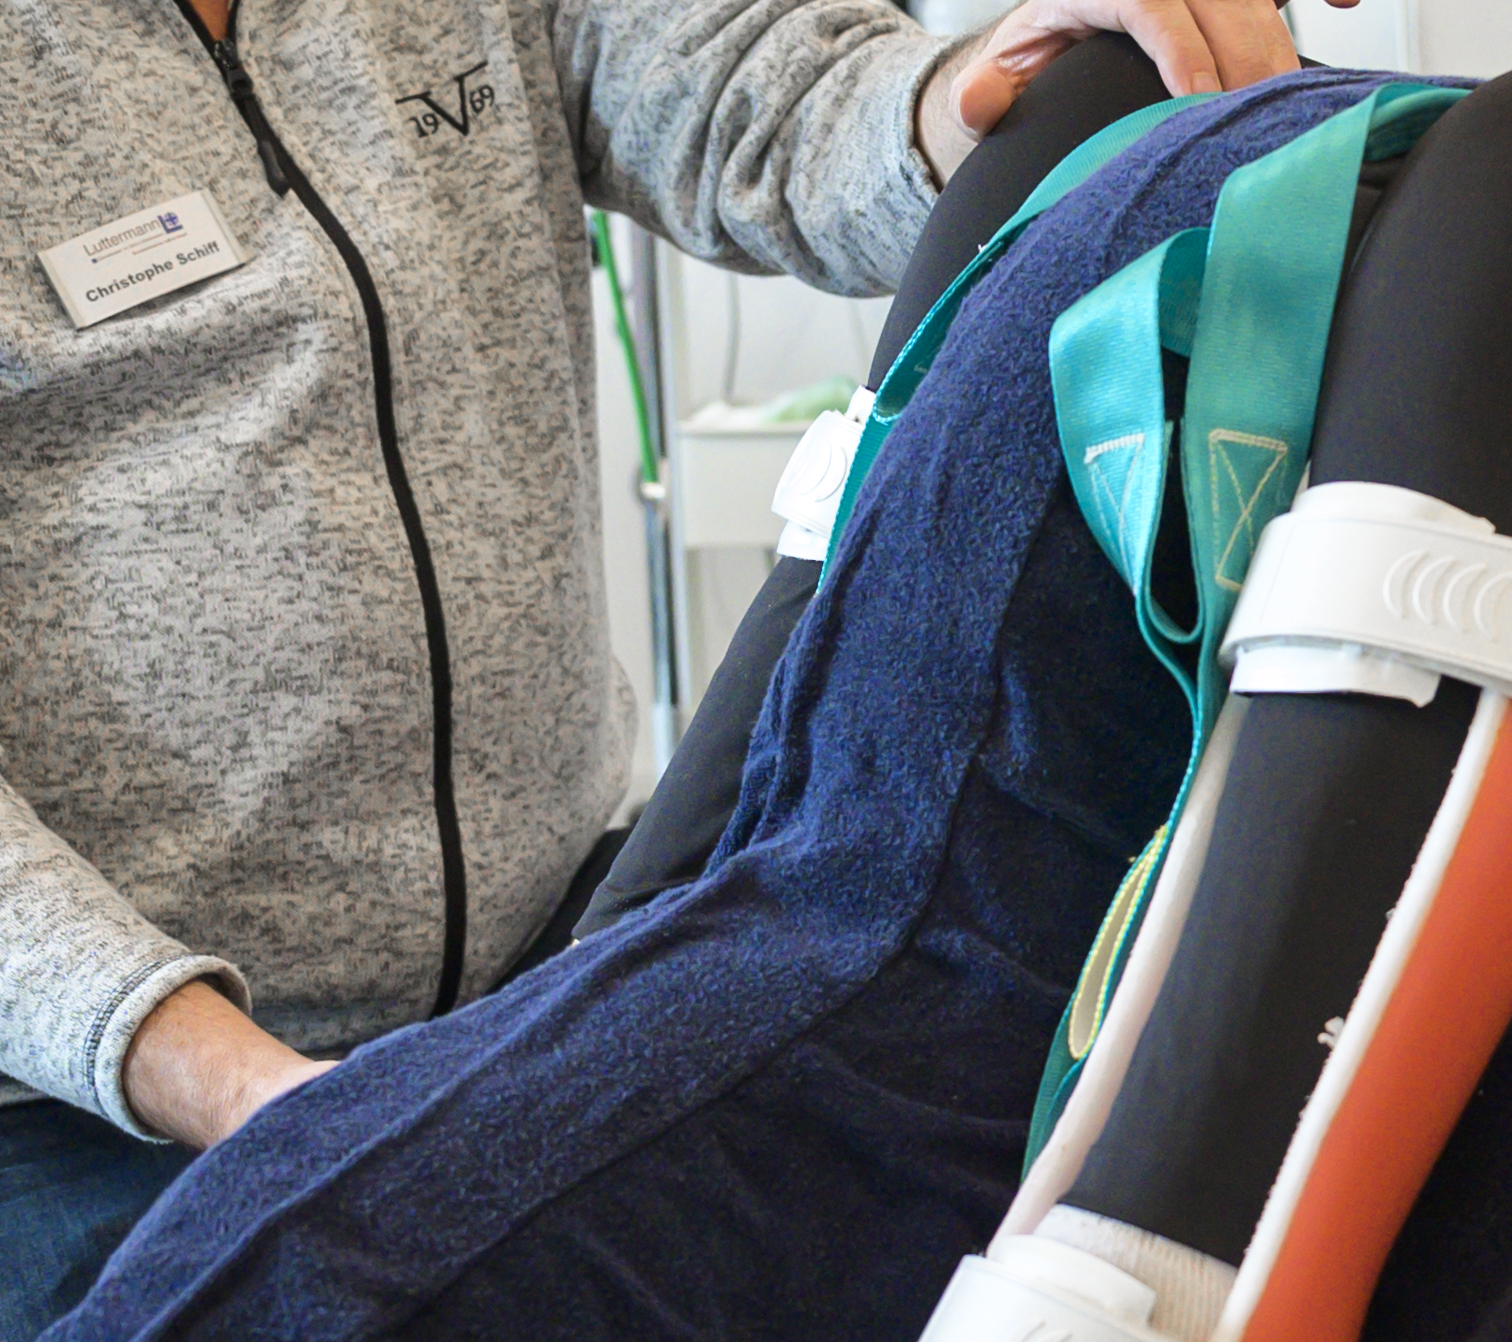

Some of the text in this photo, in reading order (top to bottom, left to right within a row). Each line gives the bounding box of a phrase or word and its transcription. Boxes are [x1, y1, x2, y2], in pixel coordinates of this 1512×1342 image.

[82, 217, 161, 257] Luttermann
[85, 260, 174, 303] Christophe
[176, 240, 220, 266] Schiff
